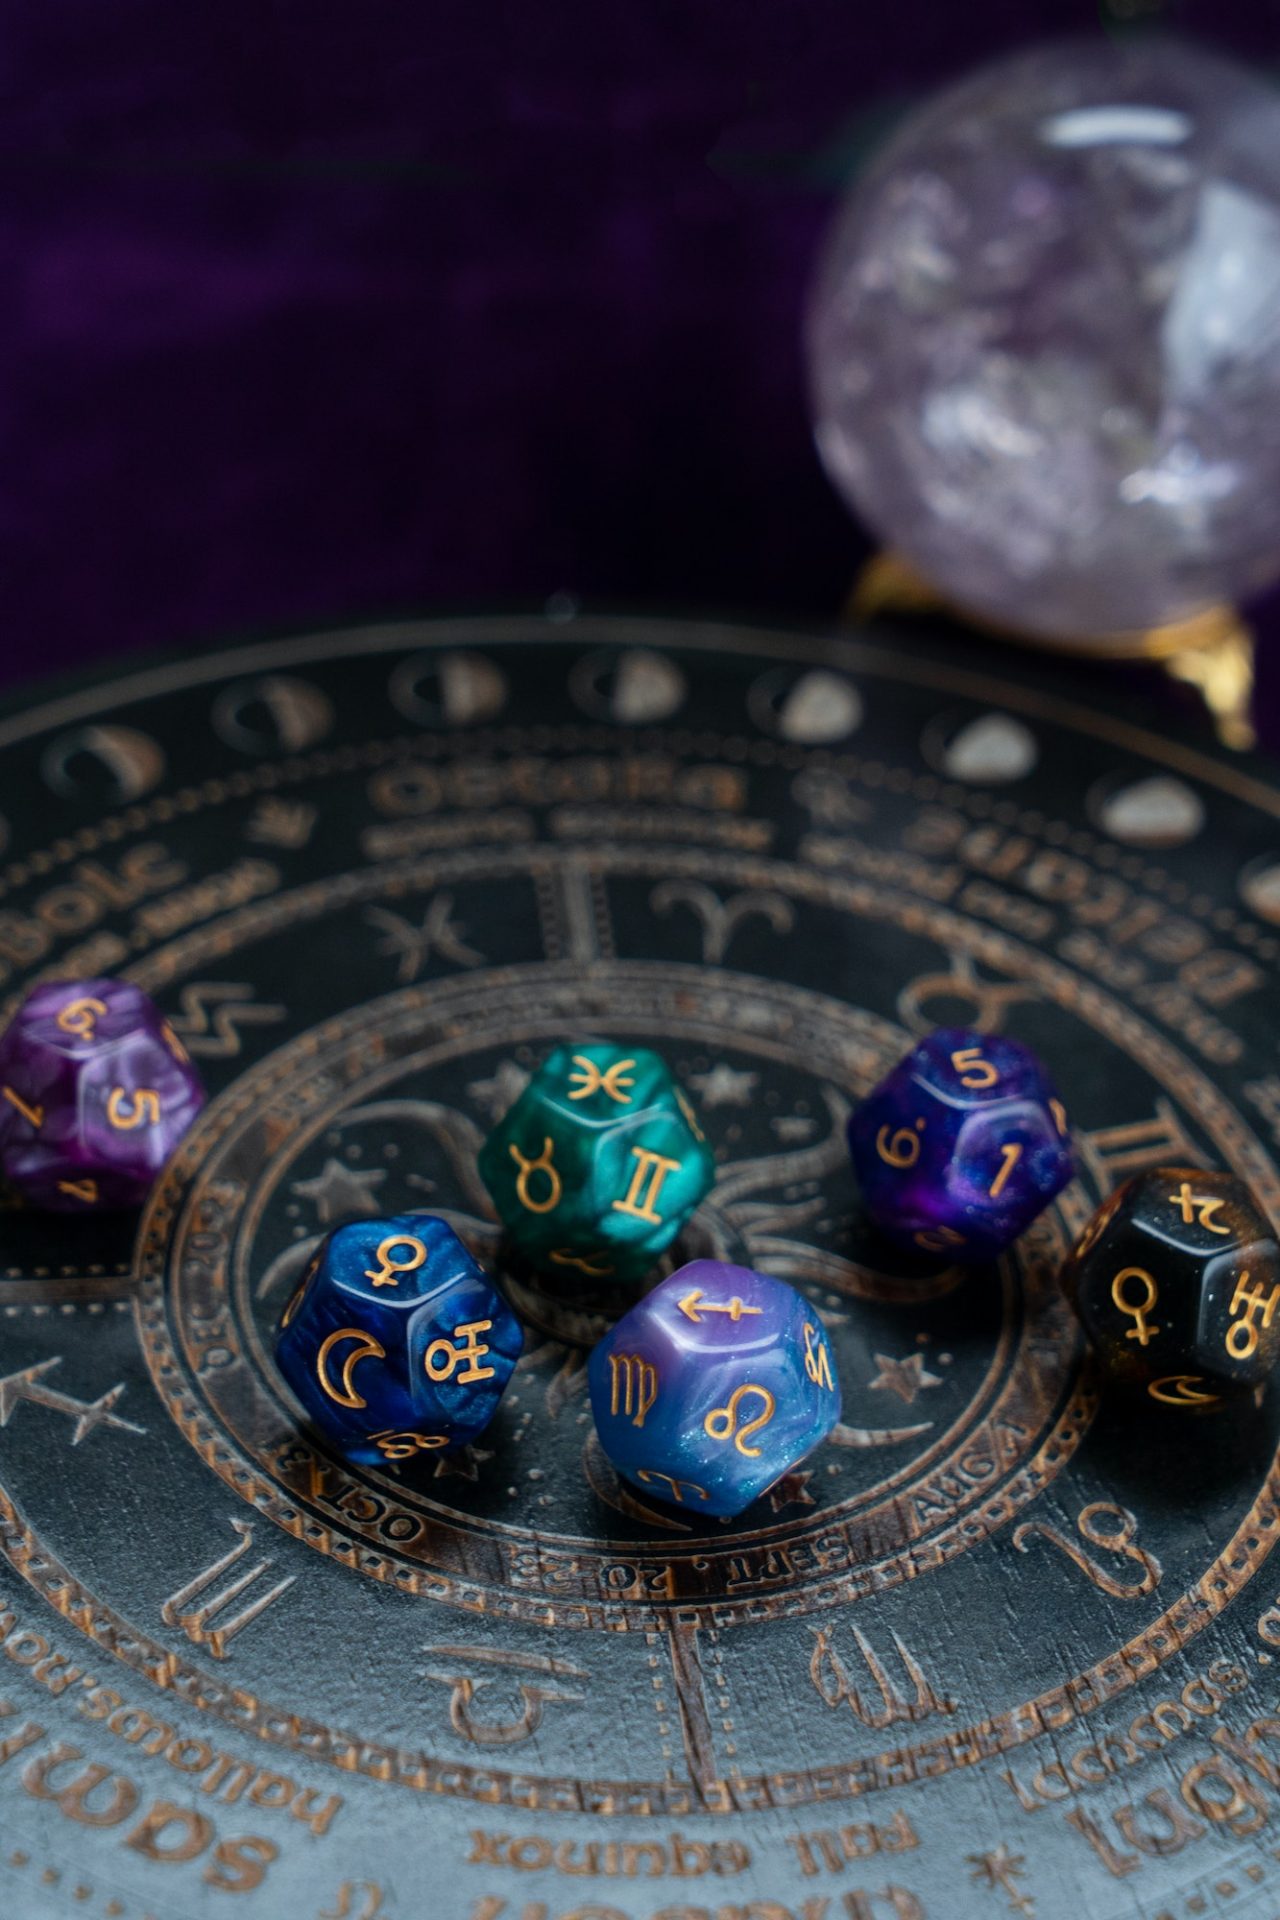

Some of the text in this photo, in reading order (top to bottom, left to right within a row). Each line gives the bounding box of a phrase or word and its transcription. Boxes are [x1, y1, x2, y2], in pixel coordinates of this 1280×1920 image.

[950, 1047, 999, 1090] 5
[105, 1086, 162, 1132] 5
[989, 1141, 1025, 1199] 1
[468, 1810, 922, 1879] fall equinox
